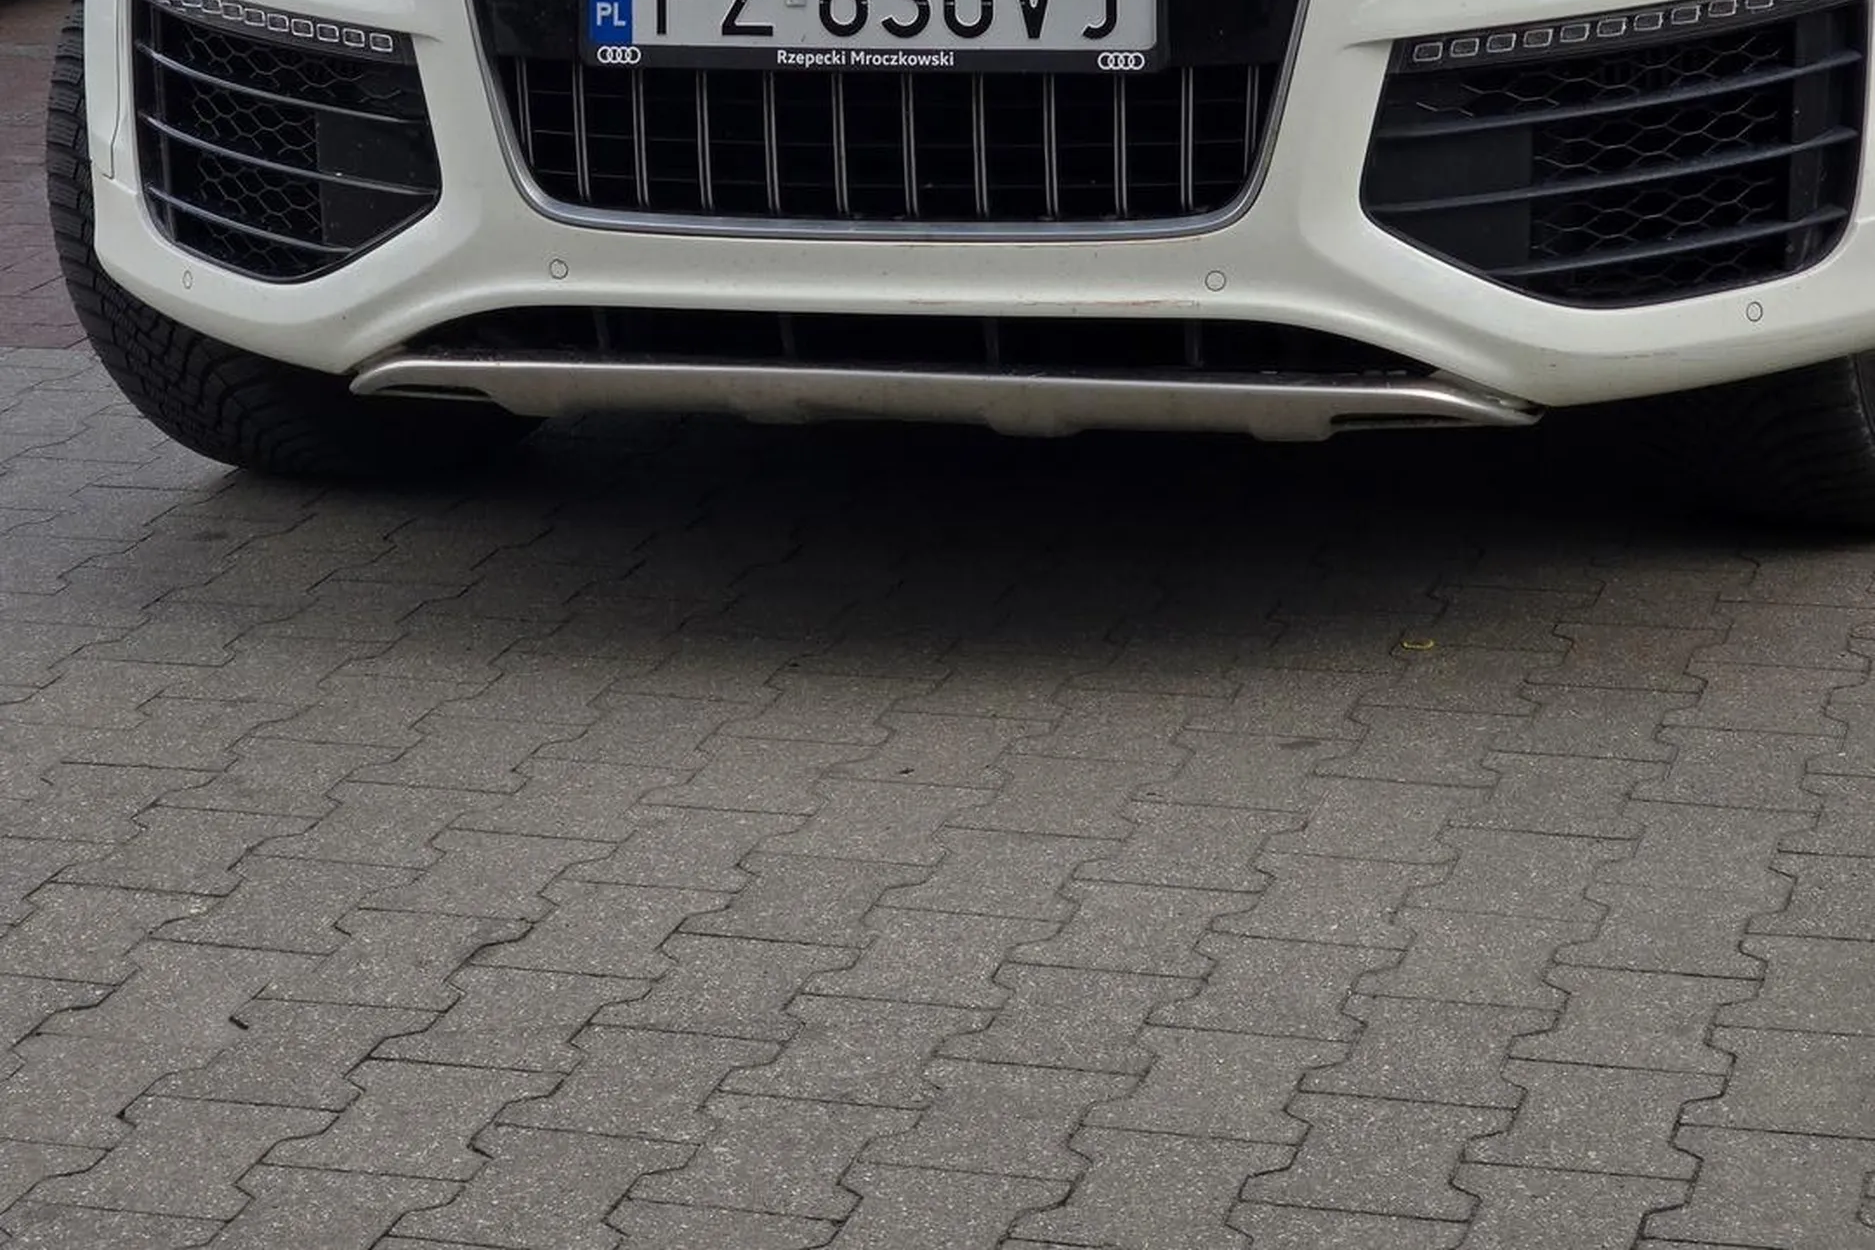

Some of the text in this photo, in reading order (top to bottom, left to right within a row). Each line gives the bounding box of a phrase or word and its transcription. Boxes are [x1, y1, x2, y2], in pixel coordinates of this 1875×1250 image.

[596, 2, 626, 27] PL
[777, 49, 955, 68] Rzepecki Mroczkowski
